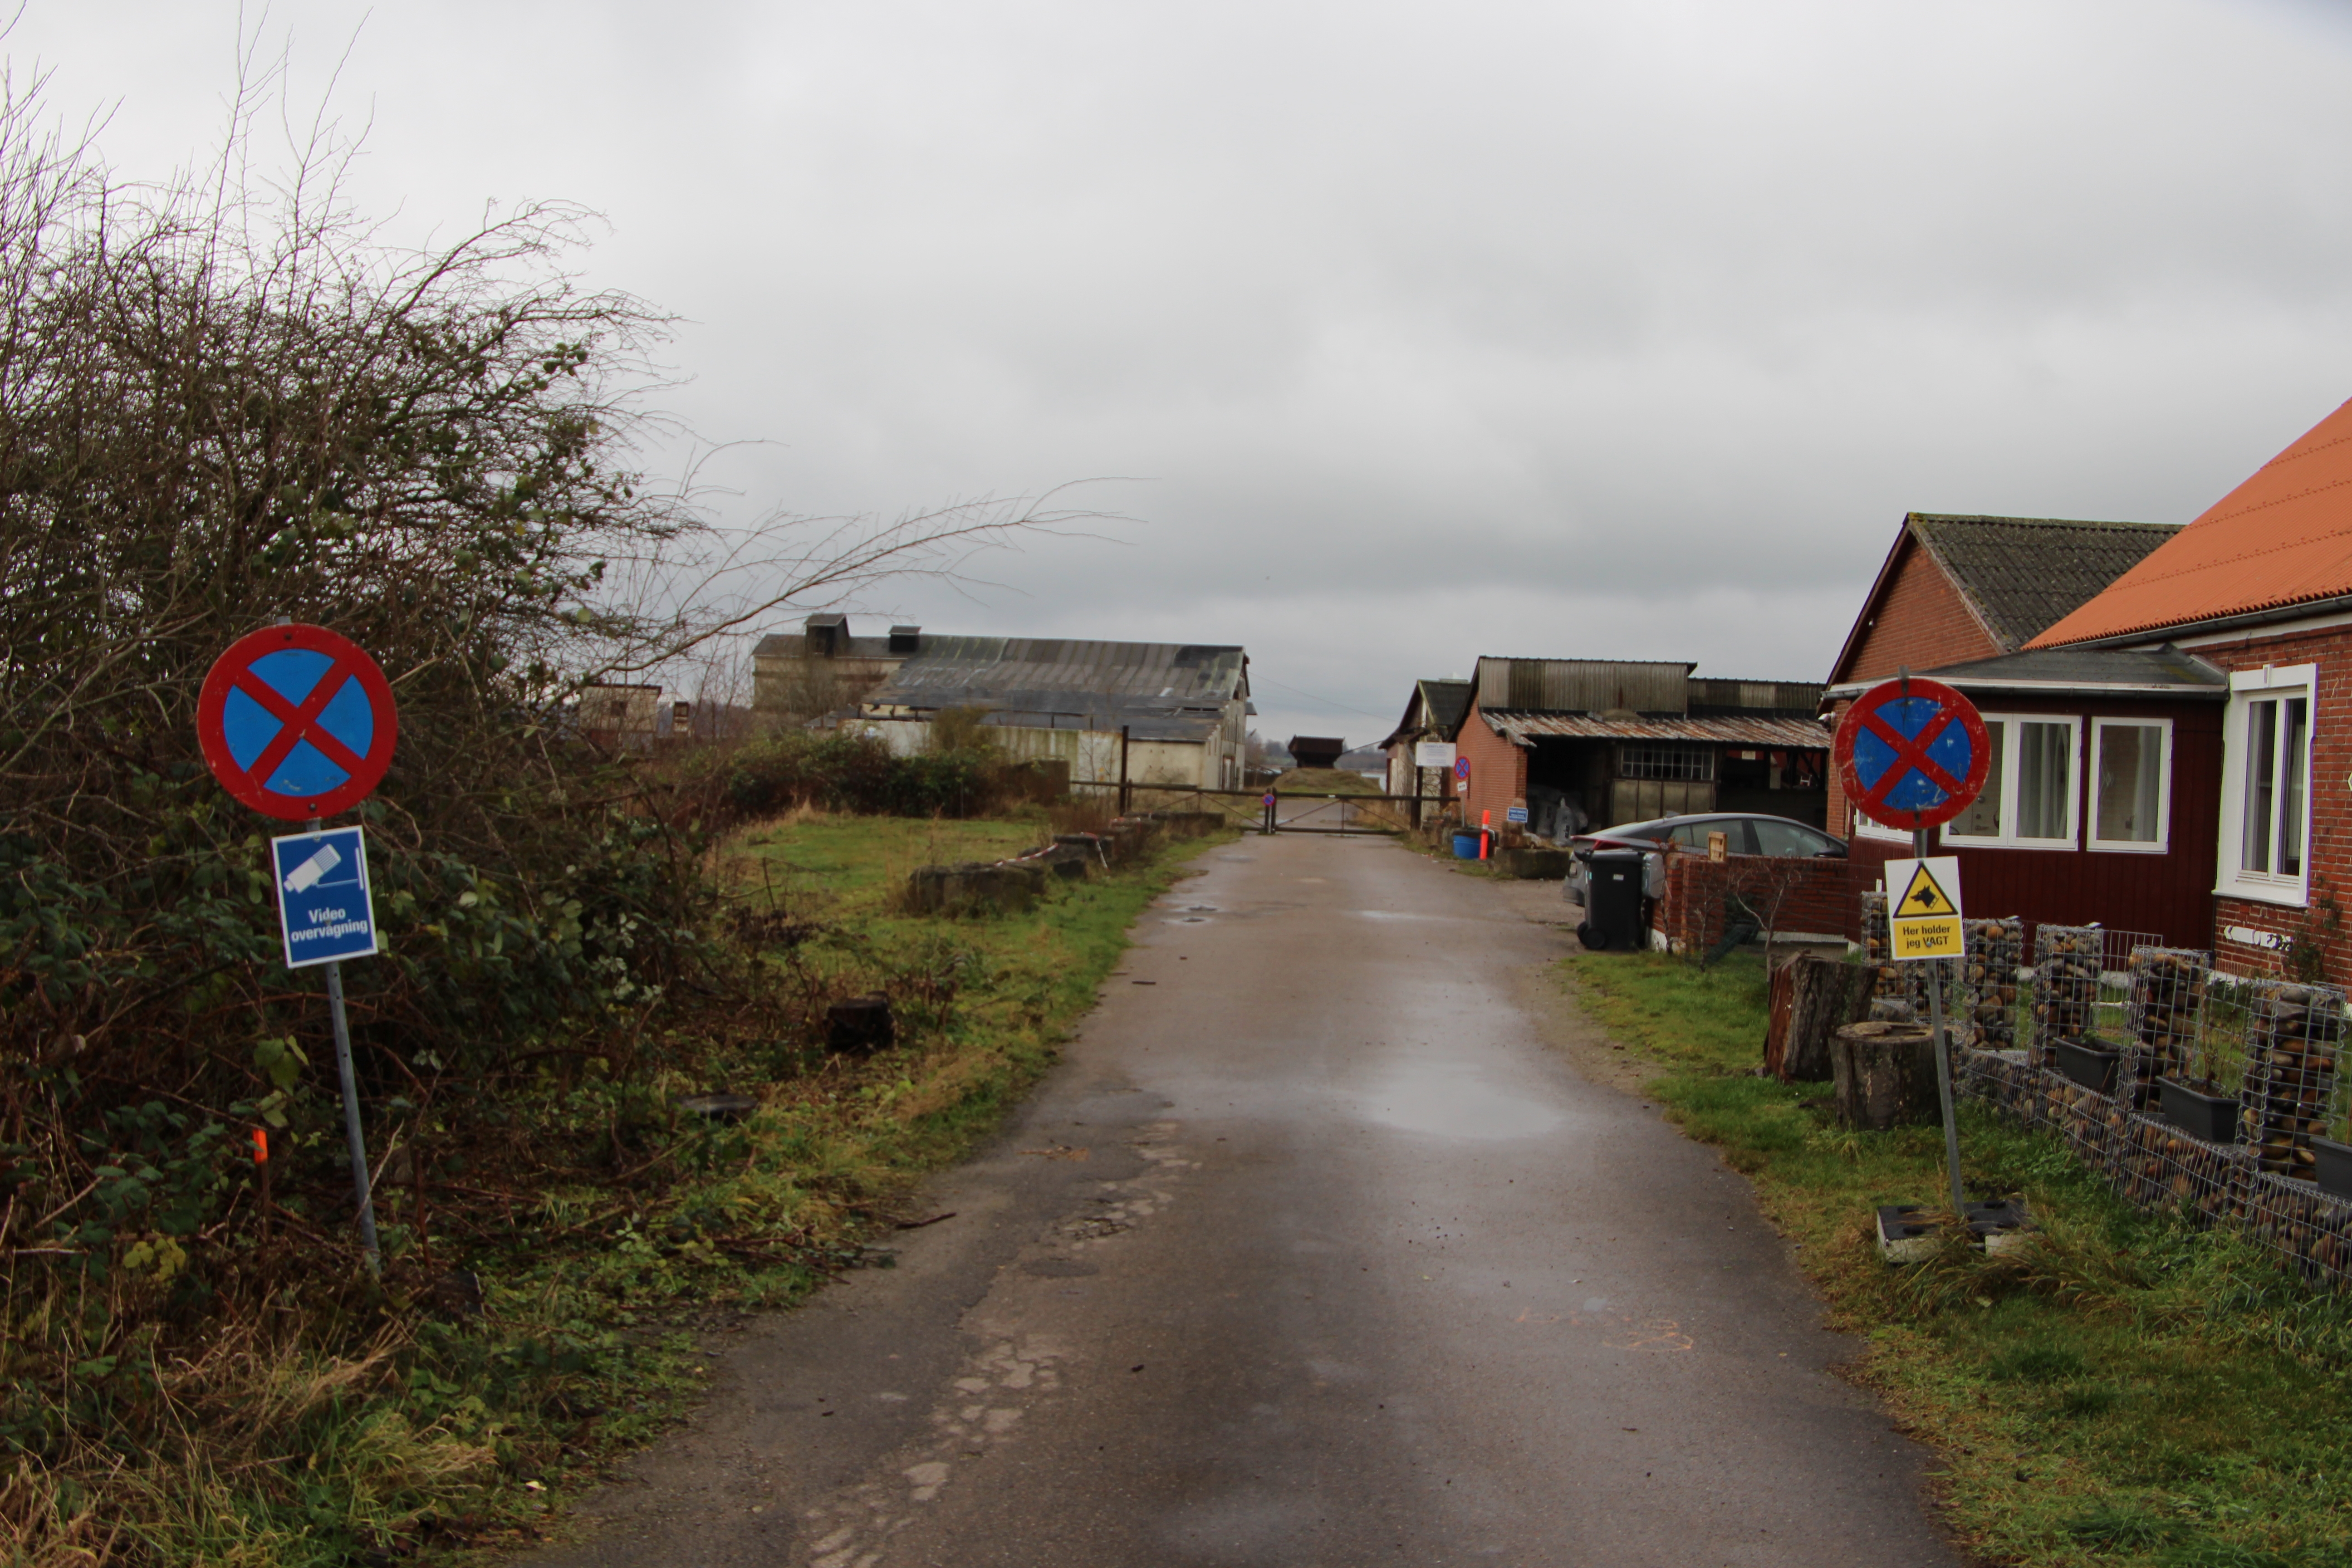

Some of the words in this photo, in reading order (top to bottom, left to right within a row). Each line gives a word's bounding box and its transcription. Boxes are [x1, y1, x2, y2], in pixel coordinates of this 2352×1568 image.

[309, 907, 346, 924] Video
[1903, 926, 1919, 936] Her
[1921, 924, 1950, 935] holder
[1906, 937, 1921, 949] jeg
[1923, 936, 1949, 946] VAGT
